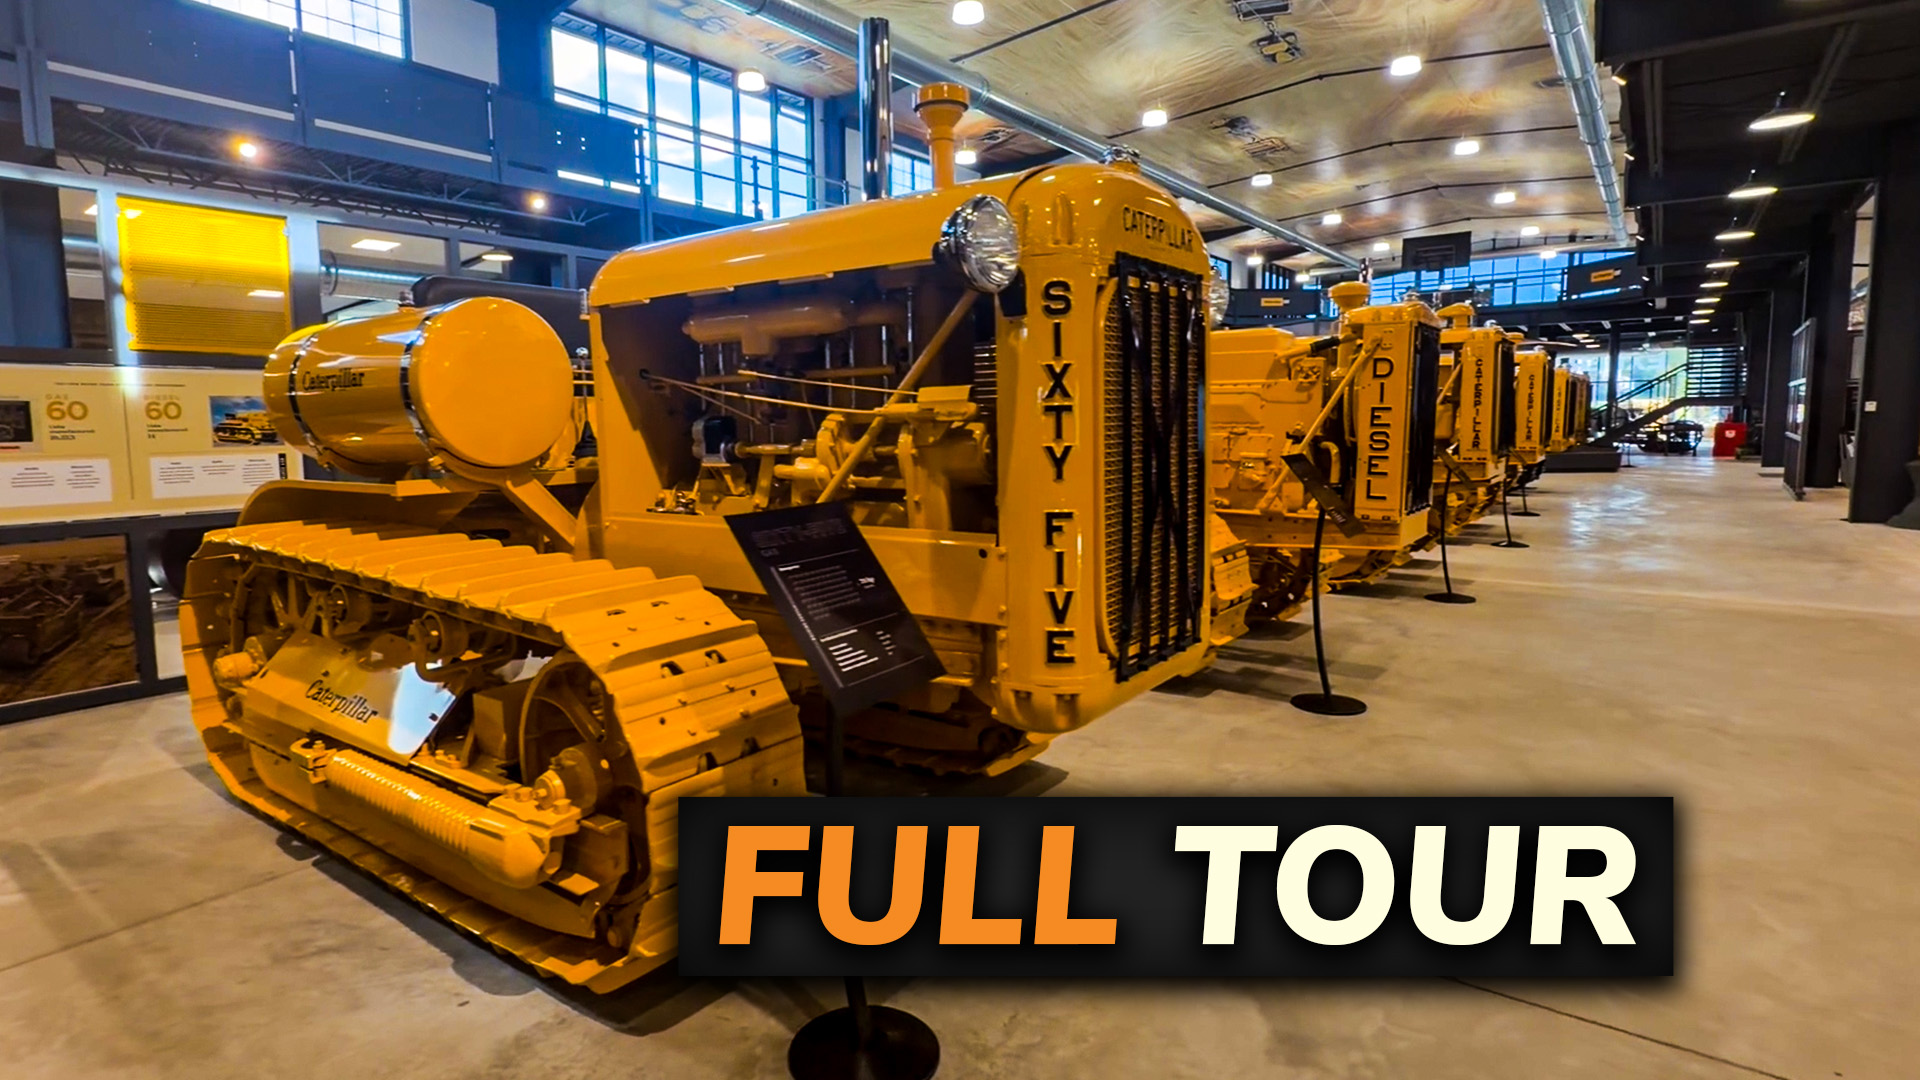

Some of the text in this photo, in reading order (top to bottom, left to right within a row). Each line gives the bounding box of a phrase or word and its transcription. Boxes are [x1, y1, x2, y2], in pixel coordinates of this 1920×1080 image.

[1122, 206, 1194, 251] CATERPILLAR
[302, 367, 365, 391] Caterpillar
[46, 400, 89, 421] 60
[145, 400, 182, 420] 60
[1472, 358, 1484, 449] CATERPILLAR
[1525, 374, 1536, 441] CATERPILLAR
[1366, 357, 1395, 501] DIESEL
[1042, 279, 1076, 665] SIXTY FIVE
[305, 679, 379, 724] Caterpillar
